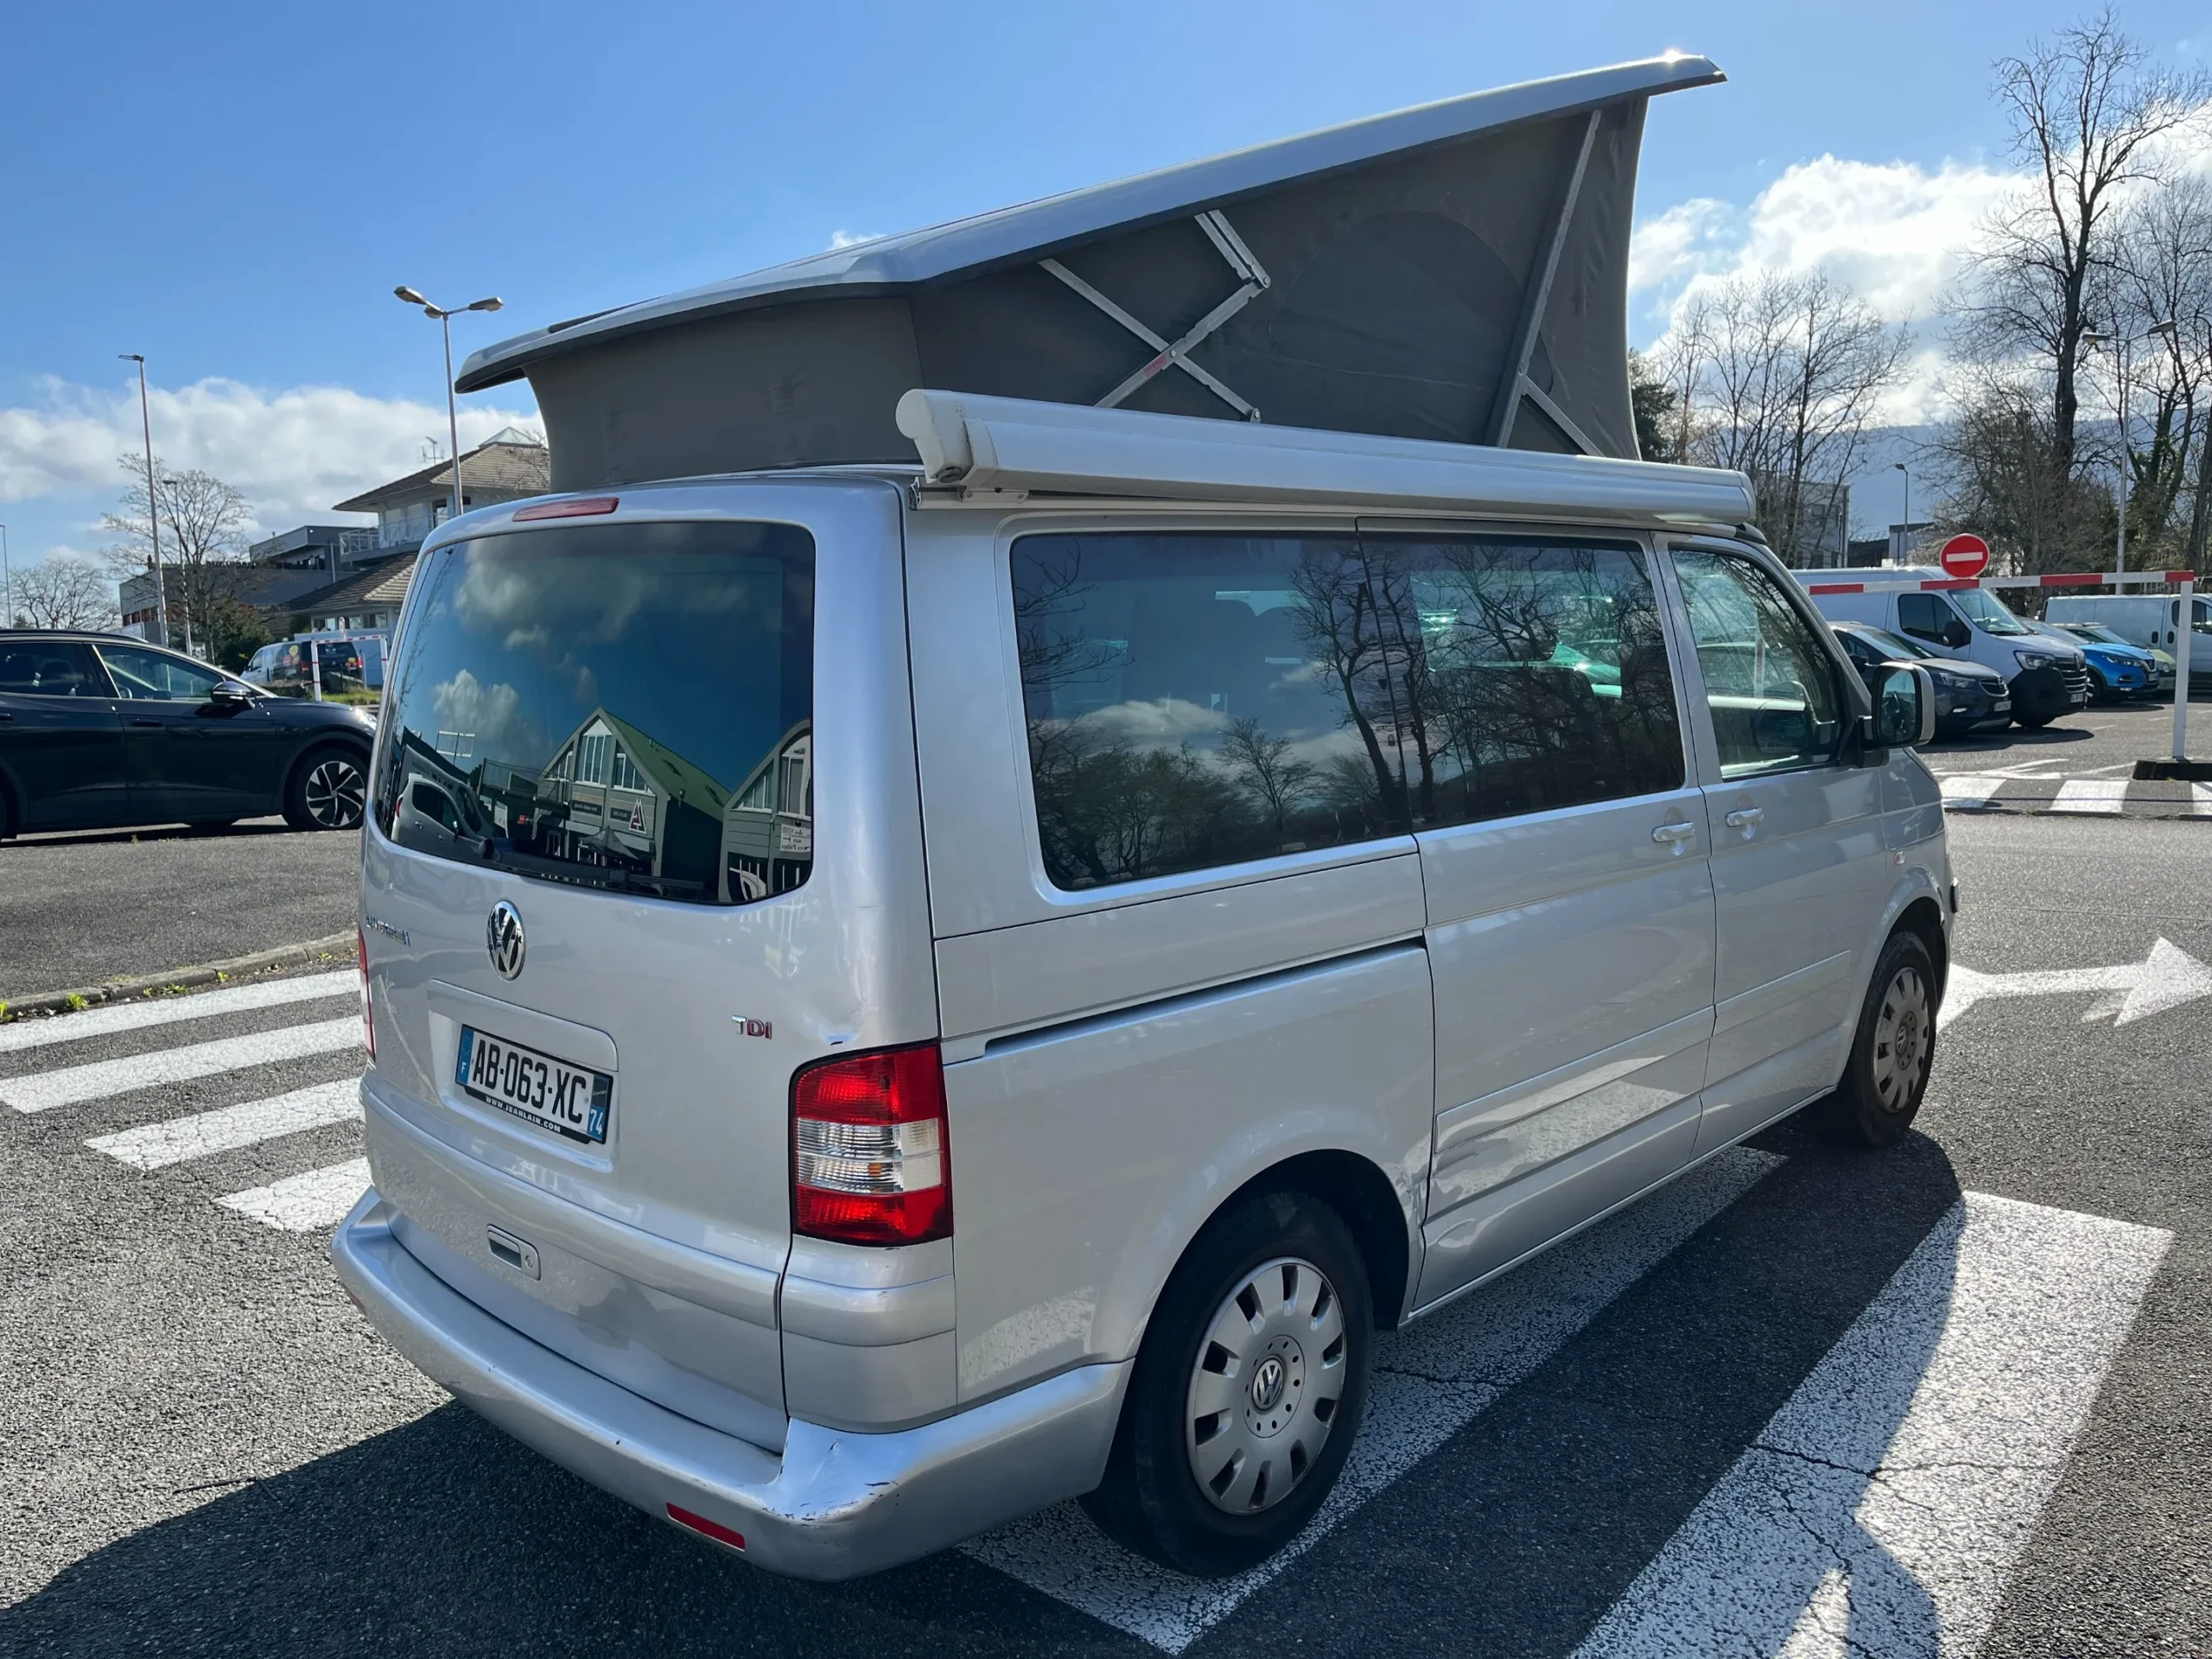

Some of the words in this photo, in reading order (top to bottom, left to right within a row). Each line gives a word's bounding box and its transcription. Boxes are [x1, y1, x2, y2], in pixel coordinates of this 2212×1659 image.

[732, 1014, 772, 1039] TDI
[461, 1062, 467, 1074] F
[473, 1039, 587, 1124] AB-063-XC
[486, 1096, 561, 1133] WWW.JEANLAIN.COM
[590, 1109, 603, 1135] 74
